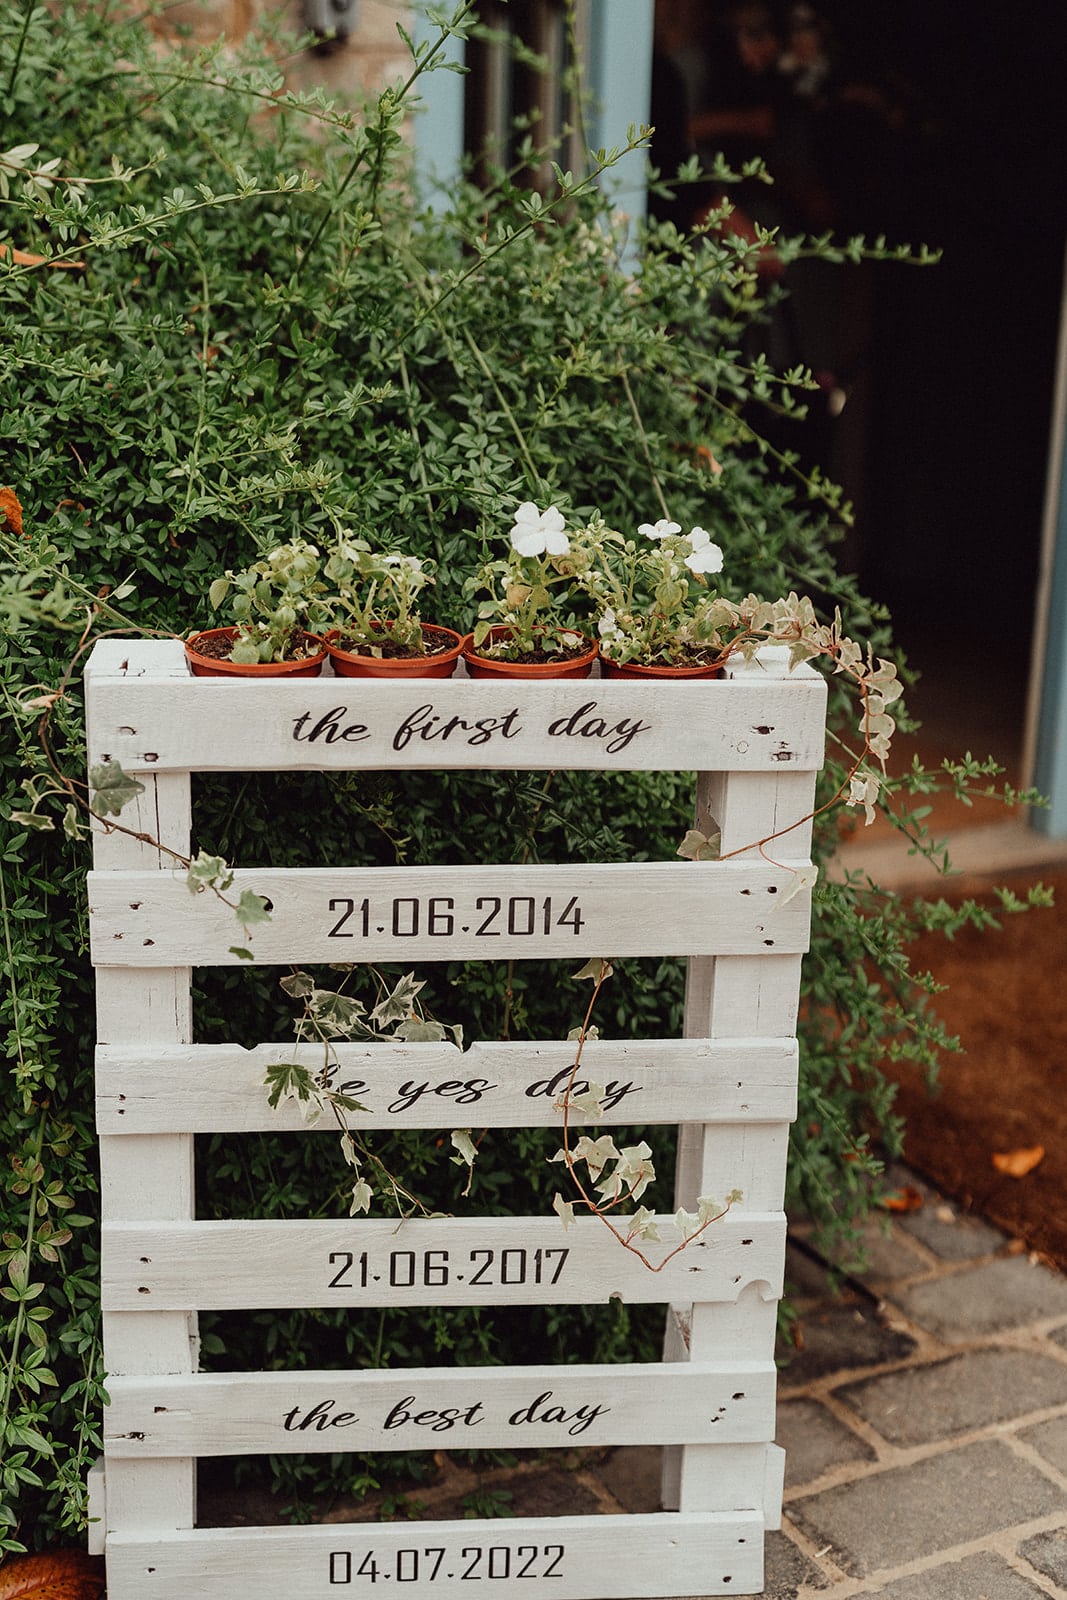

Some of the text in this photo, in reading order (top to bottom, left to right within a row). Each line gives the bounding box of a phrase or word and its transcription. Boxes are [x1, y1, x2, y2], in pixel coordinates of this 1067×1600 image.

[292, 701, 652, 754] the first day
[327, 896, 586, 937] 21.06.2014
[387, 1077, 498, 1114] yes
[327, 1248, 570, 1288] 21.06.2017
[283, 1390, 611, 1436] the best day
[328, 1545, 565, 1585] 04.07.2022
